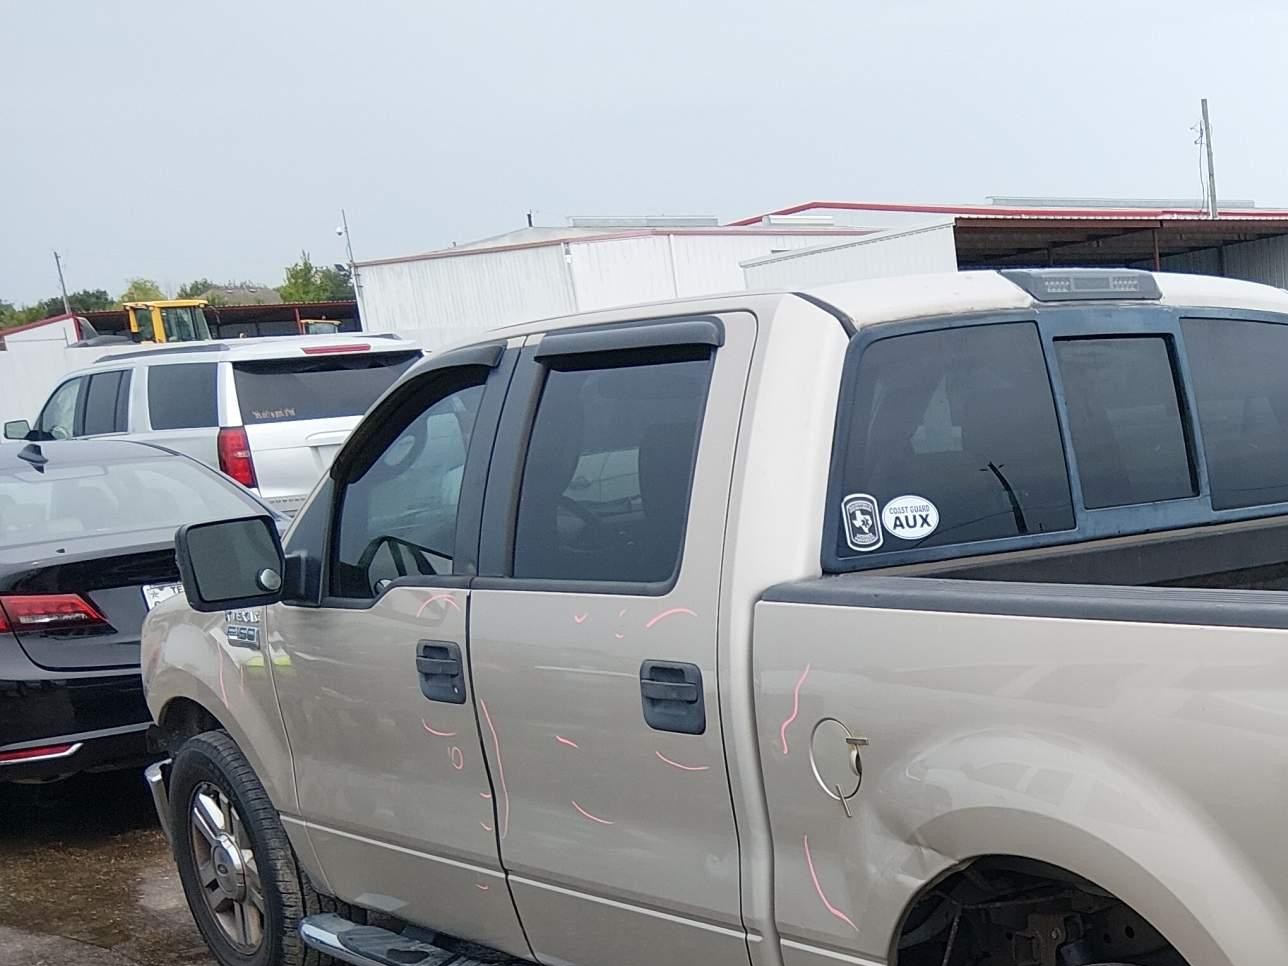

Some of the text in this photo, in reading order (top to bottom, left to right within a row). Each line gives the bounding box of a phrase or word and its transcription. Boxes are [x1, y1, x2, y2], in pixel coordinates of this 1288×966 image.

[889, 504, 930, 514] COAST GUARD
[893, 513, 932, 531] AUX
